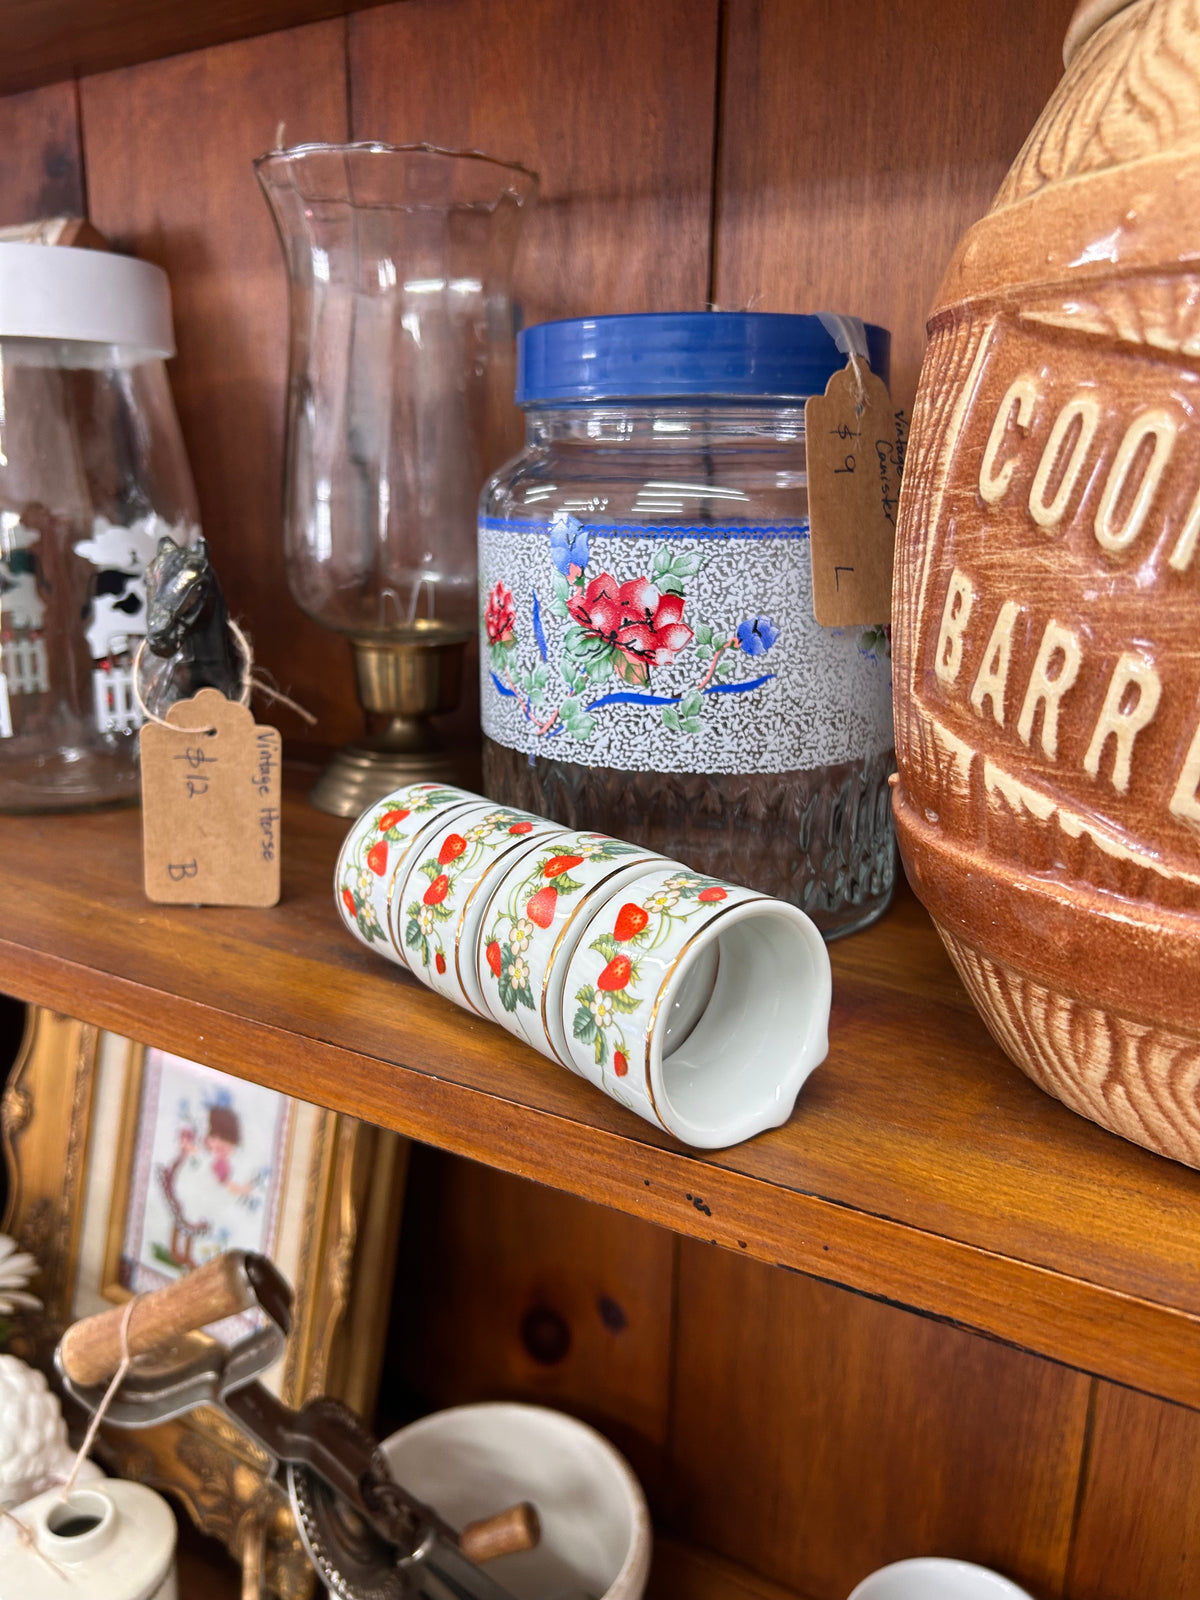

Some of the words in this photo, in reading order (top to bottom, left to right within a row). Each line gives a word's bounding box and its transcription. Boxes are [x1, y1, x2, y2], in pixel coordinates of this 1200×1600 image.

[978, 374, 1200, 572] COO
[172, 746, 219, 798] $12
[251, 731, 279, 796] Vintage
[259, 807, 280, 863] Horse
[167, 858, 198, 882] B
